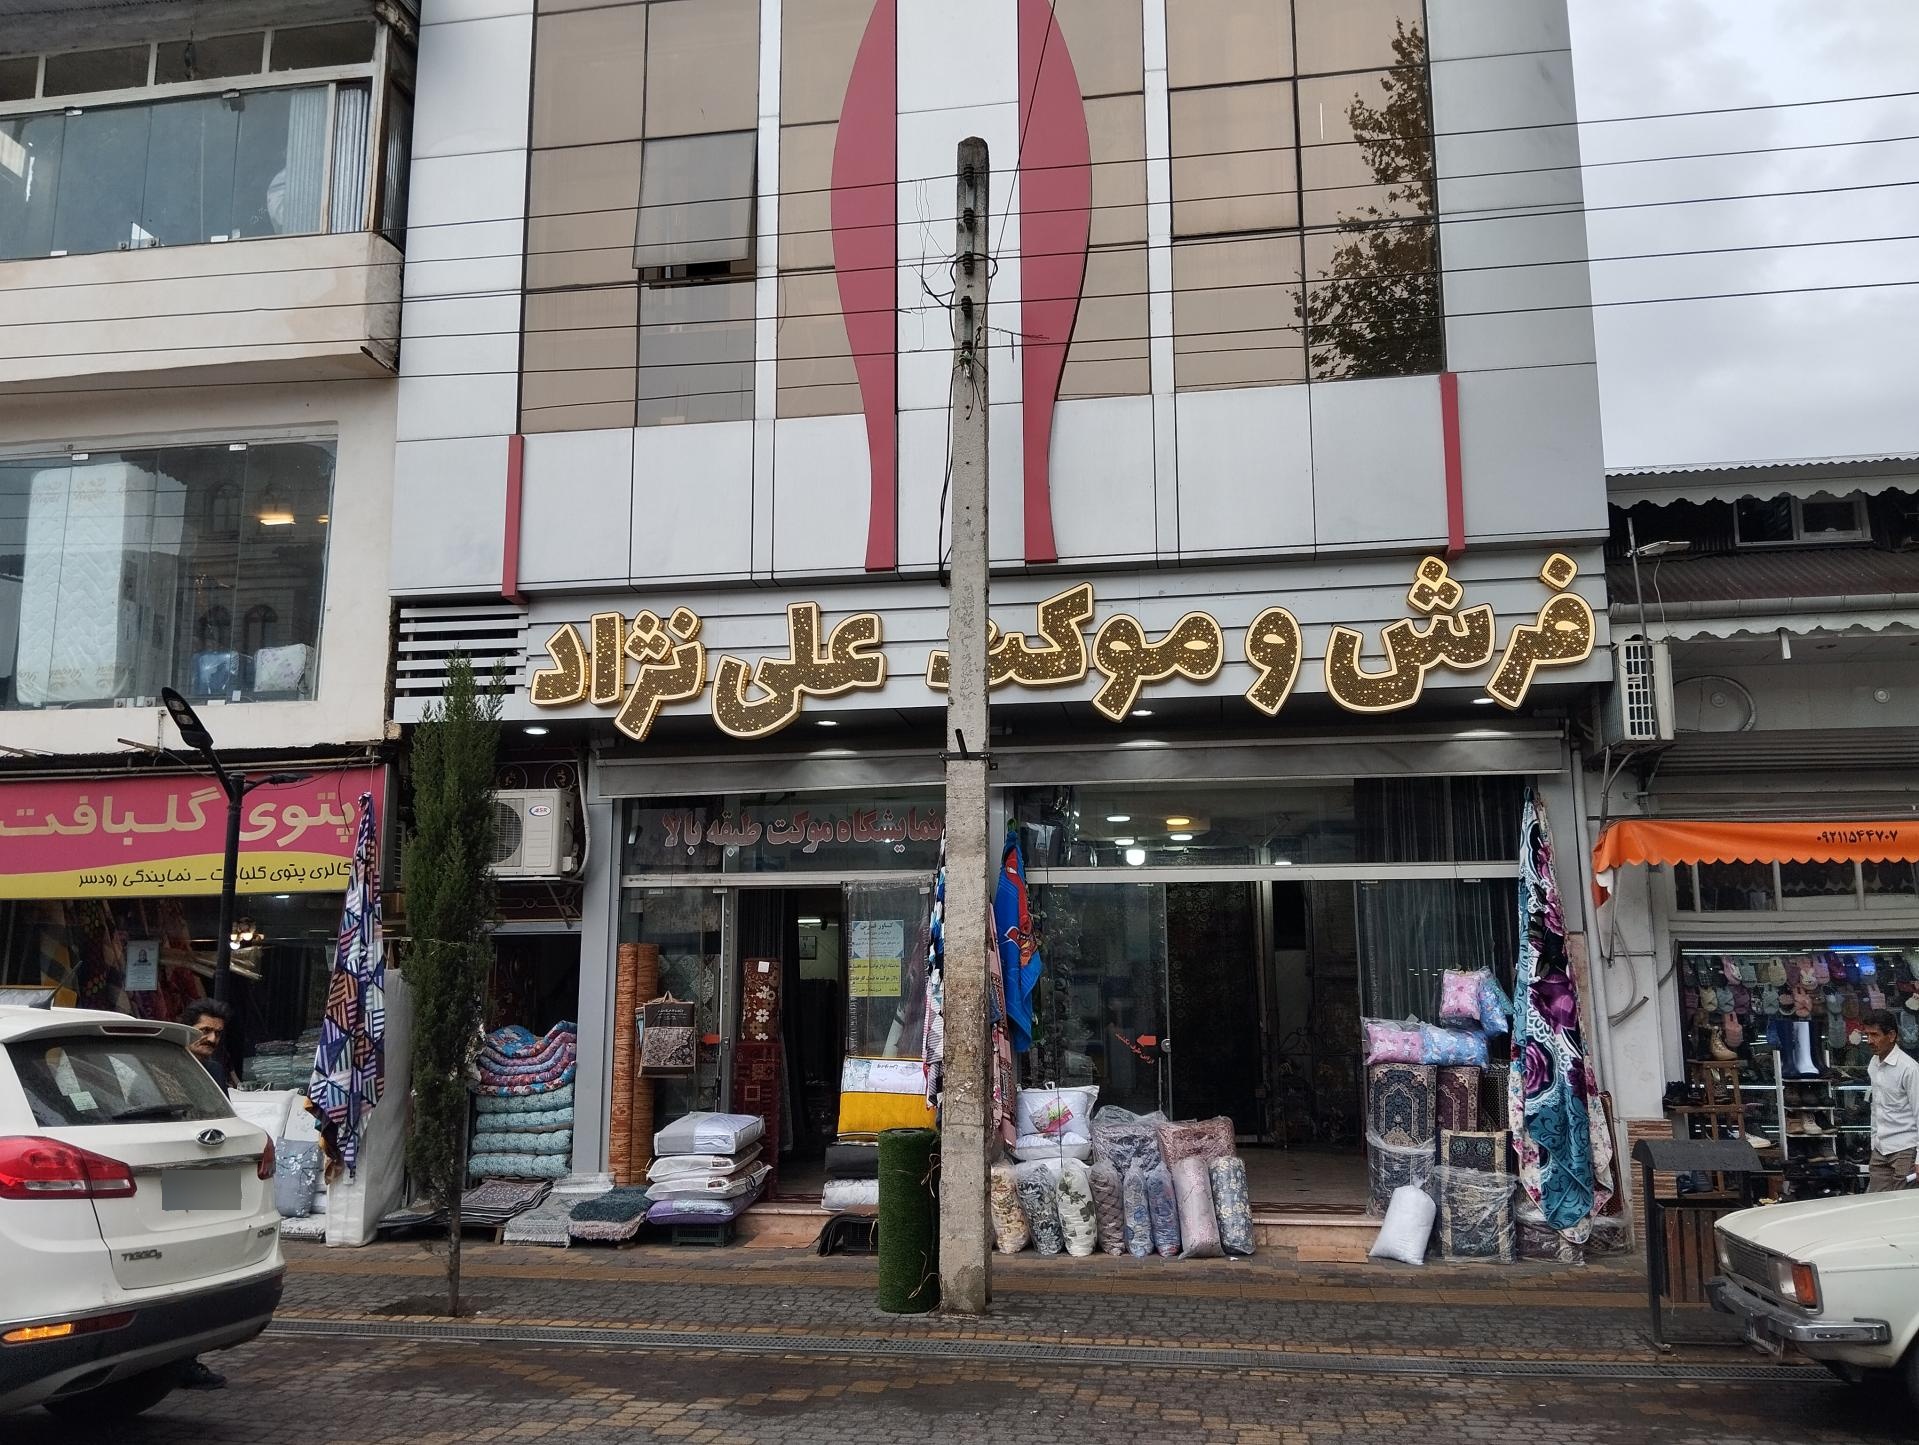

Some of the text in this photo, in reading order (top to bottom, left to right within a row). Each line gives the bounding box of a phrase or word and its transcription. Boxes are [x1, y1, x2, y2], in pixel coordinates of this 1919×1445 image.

[1244, 606, 1303, 718] و
[1325, 552, 1597, 713] فرش
[530, 605, 706, 743] نژاد
[711, 601, 887, 740] علی
[0, 786, 356, 847] پتوی گلبافت
[662, 806, 942, 857] نمایشگاه موکت طبقه بالا
[78, 873, 118, 888] رودسر
[209, 865, 267, 885] گلبات
[269, 863, 306, 884] پتوی
